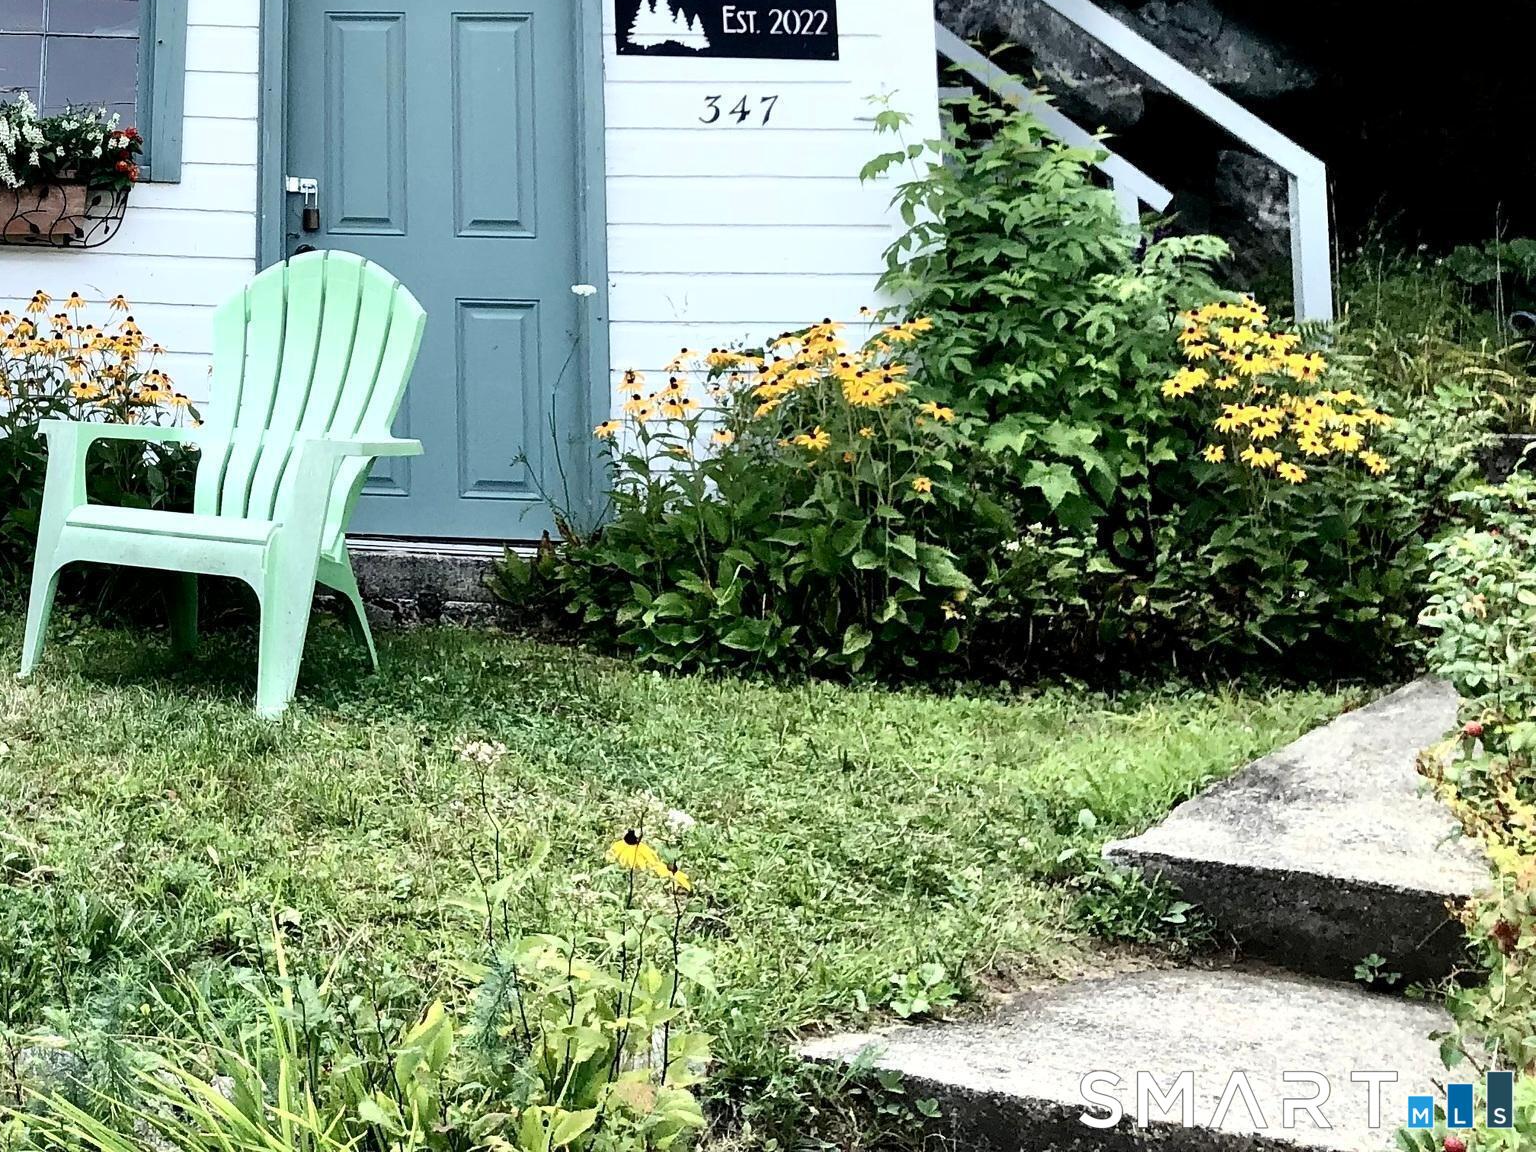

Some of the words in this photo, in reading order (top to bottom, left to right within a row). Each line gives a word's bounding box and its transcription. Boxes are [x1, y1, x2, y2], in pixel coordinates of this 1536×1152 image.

[722, 5, 761, 34] EST.
[768, 8, 828, 35] 2022
[698, 94, 779, 125] 347
